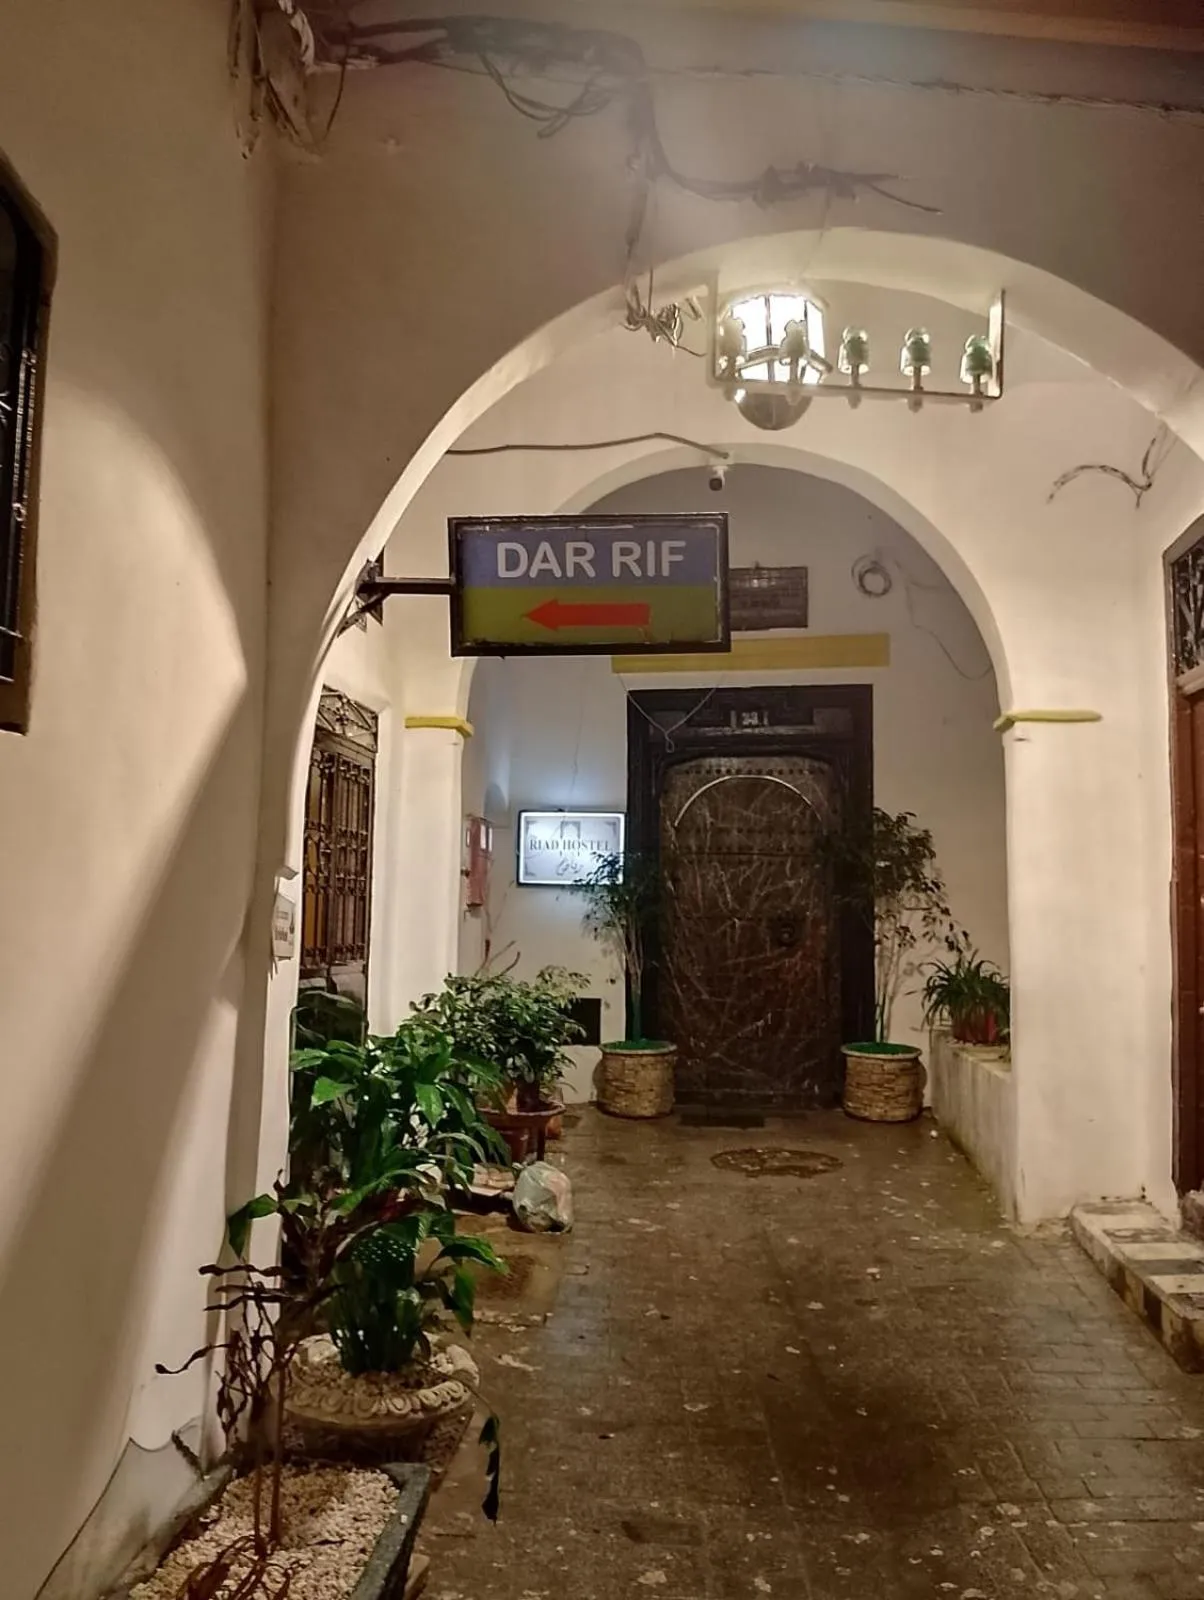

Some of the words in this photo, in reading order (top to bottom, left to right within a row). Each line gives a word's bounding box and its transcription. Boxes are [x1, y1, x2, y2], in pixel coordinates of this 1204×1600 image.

[497, 541, 596, 578] DAR
[612, 540, 687, 577] RIF
[529, 839, 560, 851] RIAD
[561, 839, 611, 852] HOSTEL
